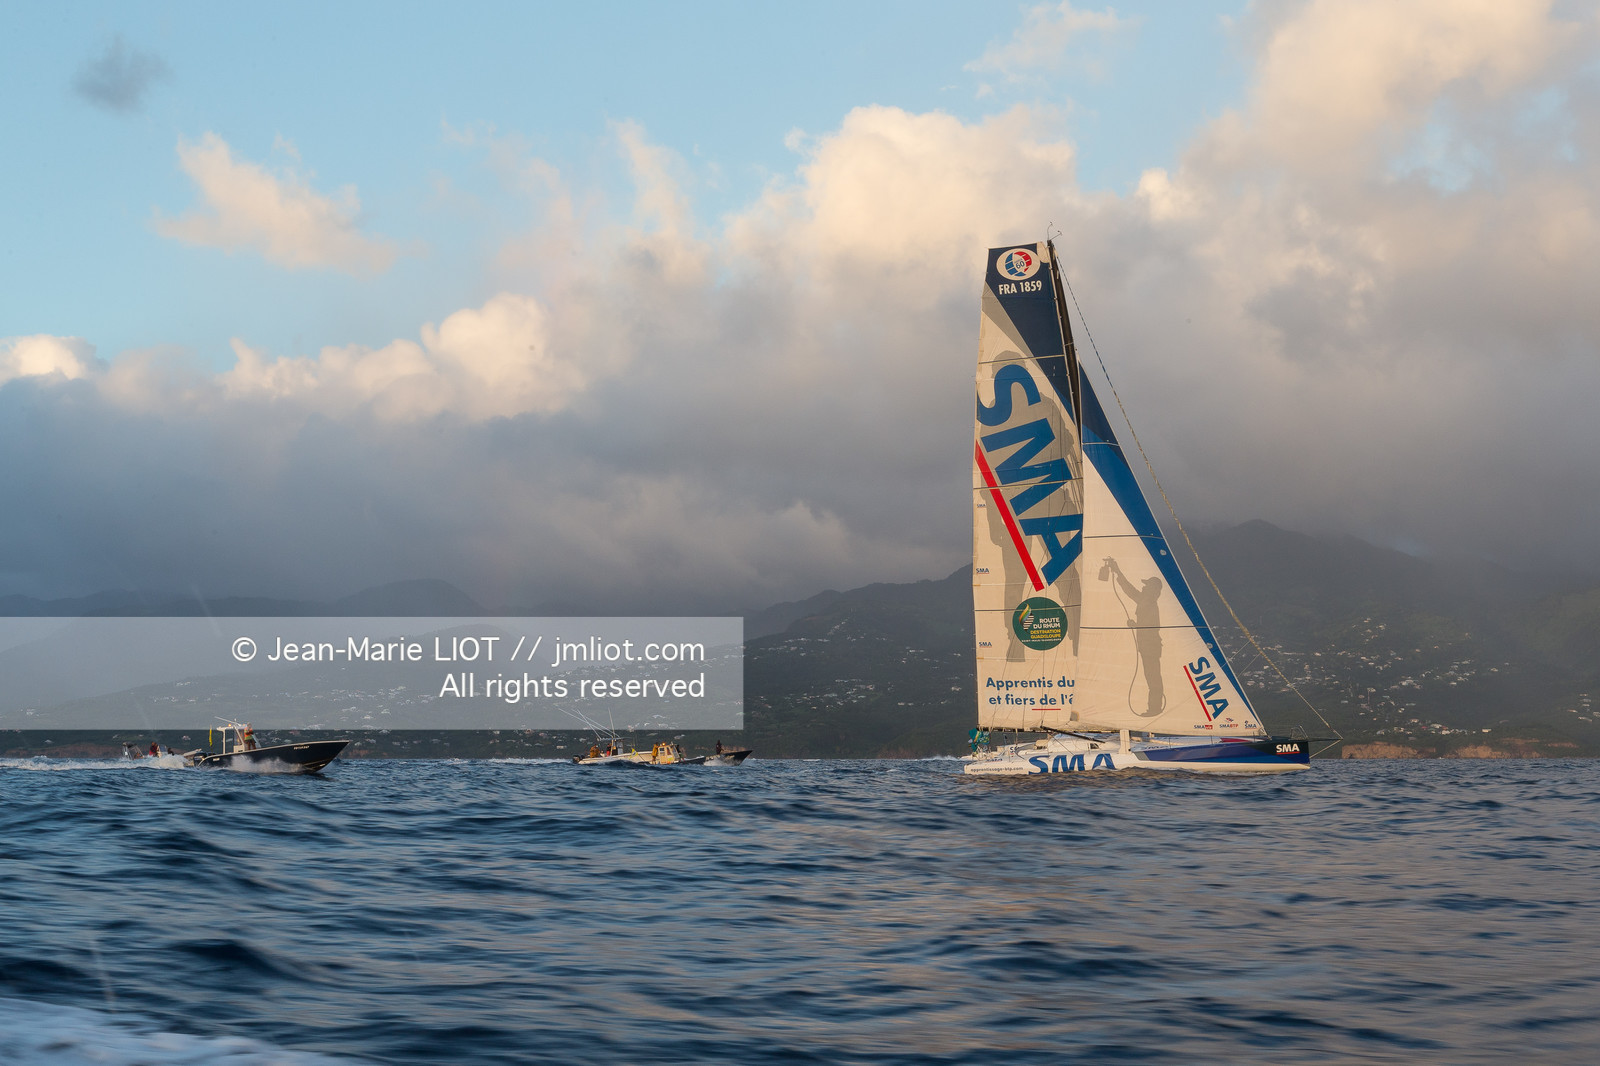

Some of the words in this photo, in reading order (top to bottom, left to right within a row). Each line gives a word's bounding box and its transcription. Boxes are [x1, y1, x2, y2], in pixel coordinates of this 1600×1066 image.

[998, 283, 1018, 295] FRA
[1020, 280, 1042, 292] 1859
[976, 364, 1083, 586] SMA
[986, 677, 1053, 691] Apprentis
[1057, 676, 1075, 688] du
[1188, 656, 1229, 719] SMA
[988, 695, 1002, 705] et
[1005, 694, 1035, 706] fiers
[1039, 694, 1057, 706] de
[1275, 743, 1300, 753] SMA
[1028, 753, 1116, 775] SMA
